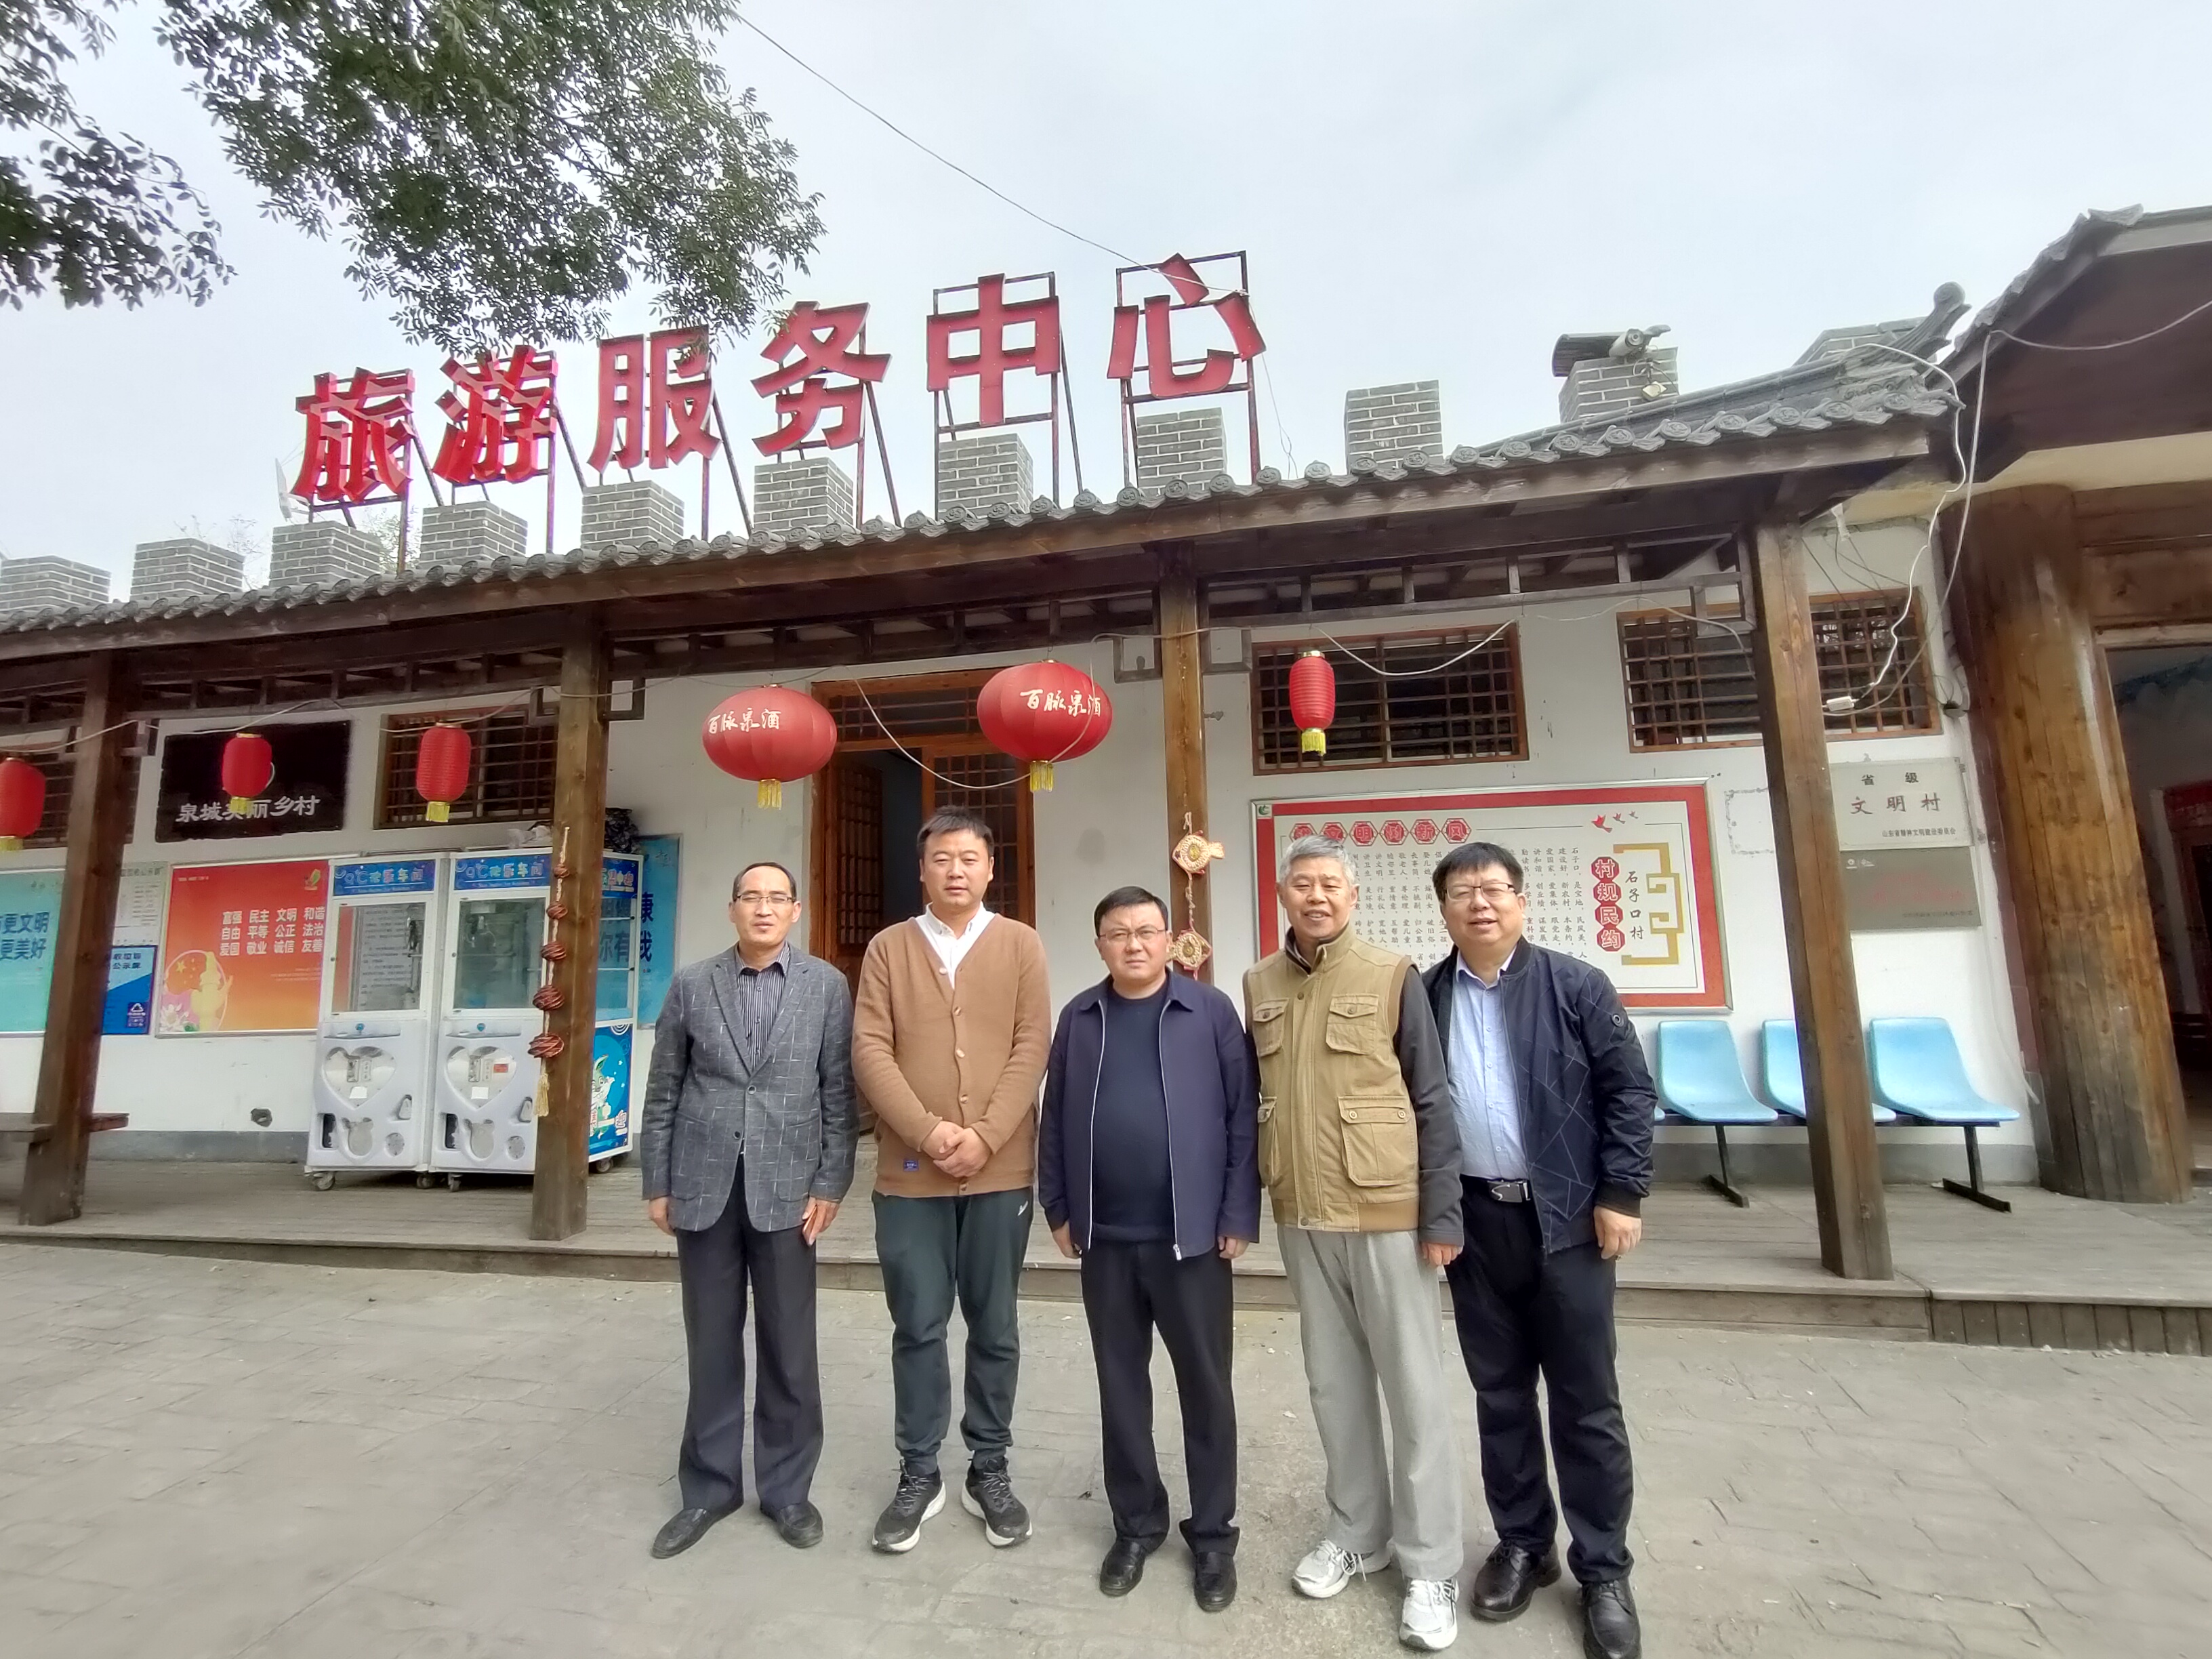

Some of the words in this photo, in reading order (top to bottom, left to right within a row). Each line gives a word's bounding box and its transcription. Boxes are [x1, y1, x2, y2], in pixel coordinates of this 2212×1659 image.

[291, 253, 1267, 503] 旅游服务中心
[1020, 689, 1101, 717] 百脉泉酒
[708, 708, 781, 733] 百脉泉酒
[1861, 772, 1919, 785] 省级
[1850, 792, 1940, 815] 文明村
[222, 911, 243, 924] 富强
[249, 909, 270, 923] 民主
[276, 908, 298, 922] 文明
[304, 906, 326, 920] 和谐
[1595, 859, 1621, 949] 村规民约
[1625, 870, 1644, 940] 石子口村
[0, 912, 49, 934] 更文明
[222, 927, 241, 940] 自由
[247, 925, 268, 939] 平等
[274, 924, 295, 937] 公正
[302, 922, 324, 937] 法治
[220, 942, 240, 956] 爱国
[247, 941, 267, 955] 敬业
[274, 940, 295, 954] 诚信
[302, 939, 323, 953] 友善
